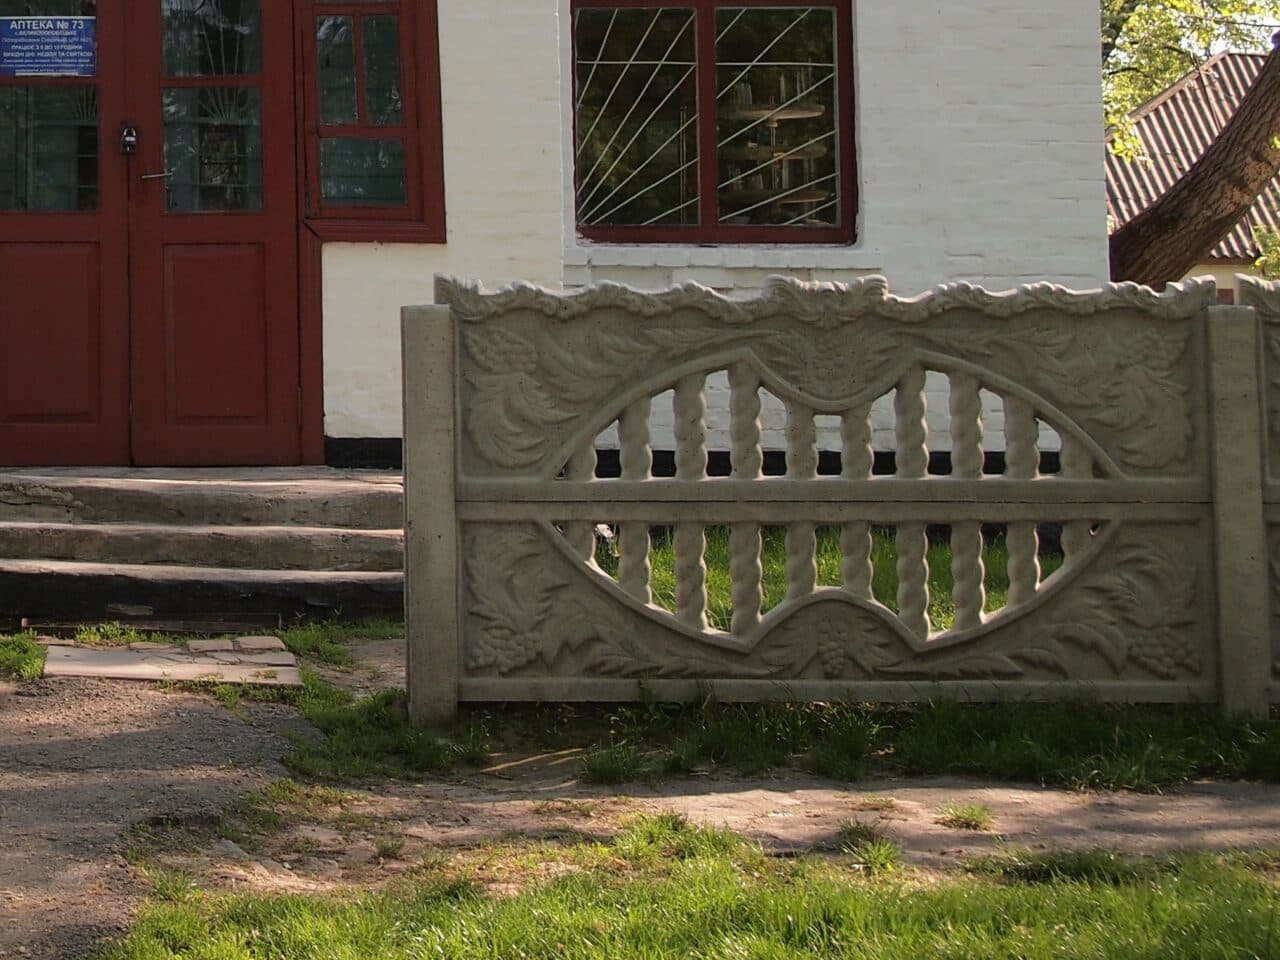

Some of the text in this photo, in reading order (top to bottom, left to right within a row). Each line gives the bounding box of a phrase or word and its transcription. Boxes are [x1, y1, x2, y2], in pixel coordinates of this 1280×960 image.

[10, 20, 84, 29] АПТЕКА № 73
